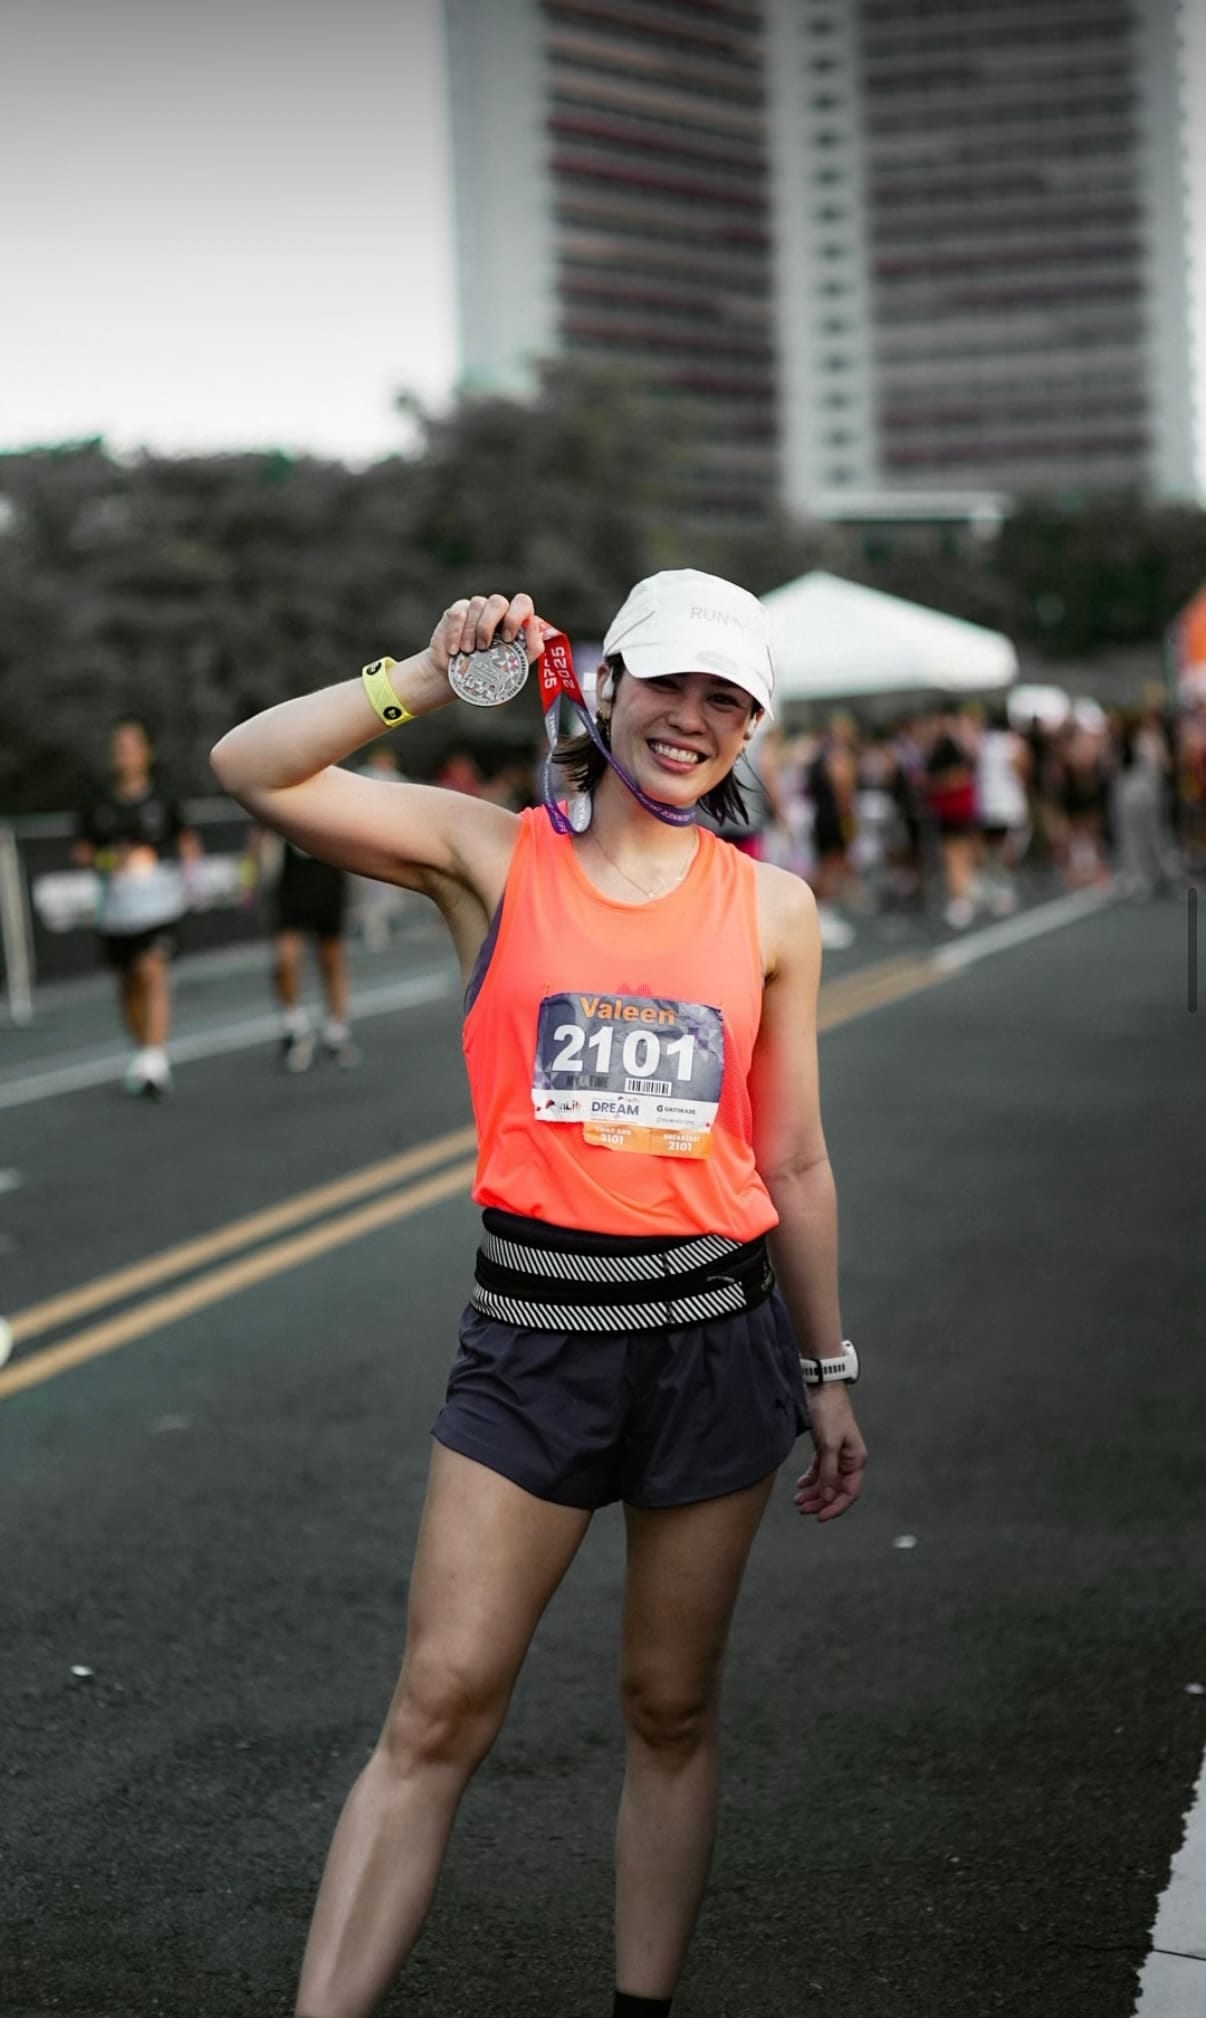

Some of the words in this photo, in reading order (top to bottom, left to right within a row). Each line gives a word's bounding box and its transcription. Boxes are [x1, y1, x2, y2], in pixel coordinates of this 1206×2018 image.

[550, 646, 576, 689] 2025
[580, 997, 676, 1025] Valeen
[552, 1024, 696, 1081] 2101
[592, 1101, 640, 1116] DREAM
[667, 1141, 692, 1152] 2101
